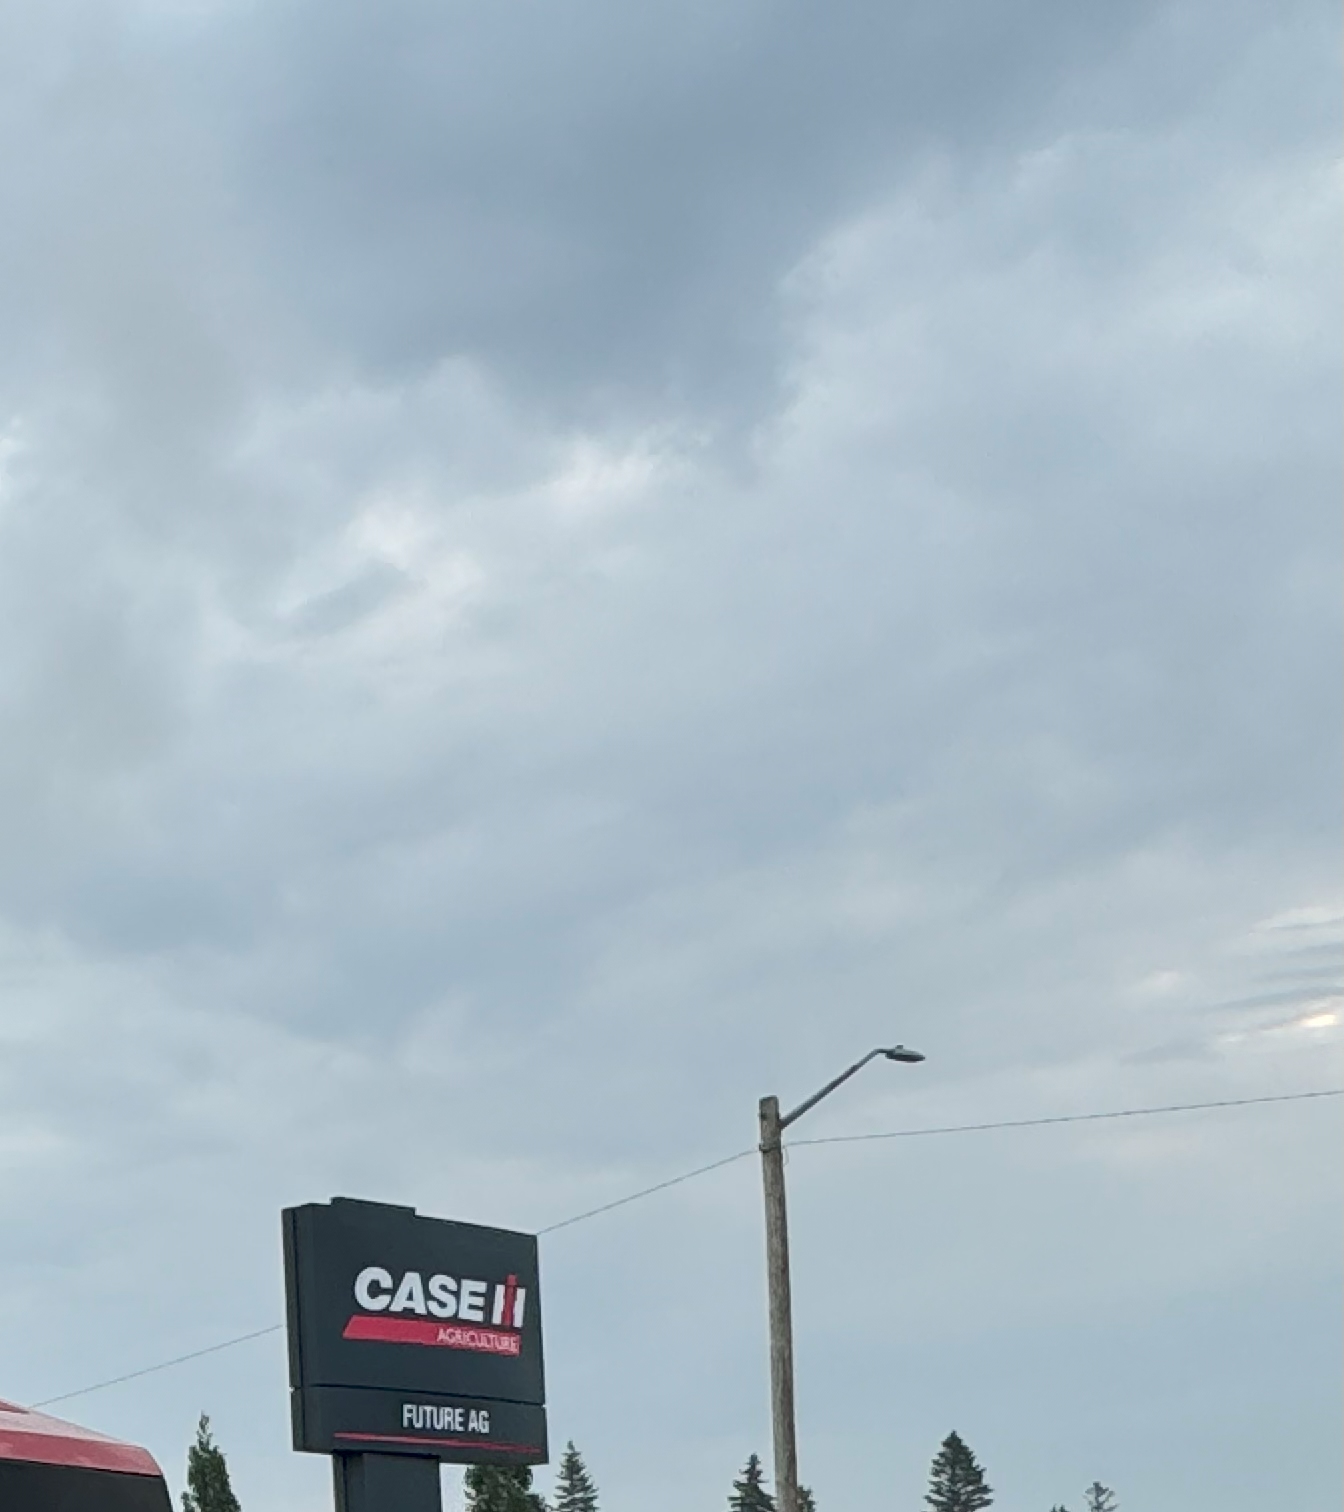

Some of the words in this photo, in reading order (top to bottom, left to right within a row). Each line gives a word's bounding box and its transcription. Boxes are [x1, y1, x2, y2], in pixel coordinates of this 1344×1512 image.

[354, 1266, 488, 1323] CASE
[436, 1328, 519, 1353] AGRICULTURE
[402, 1404, 465, 1432] FUTURE
[468, 1410, 490, 1434] AG
